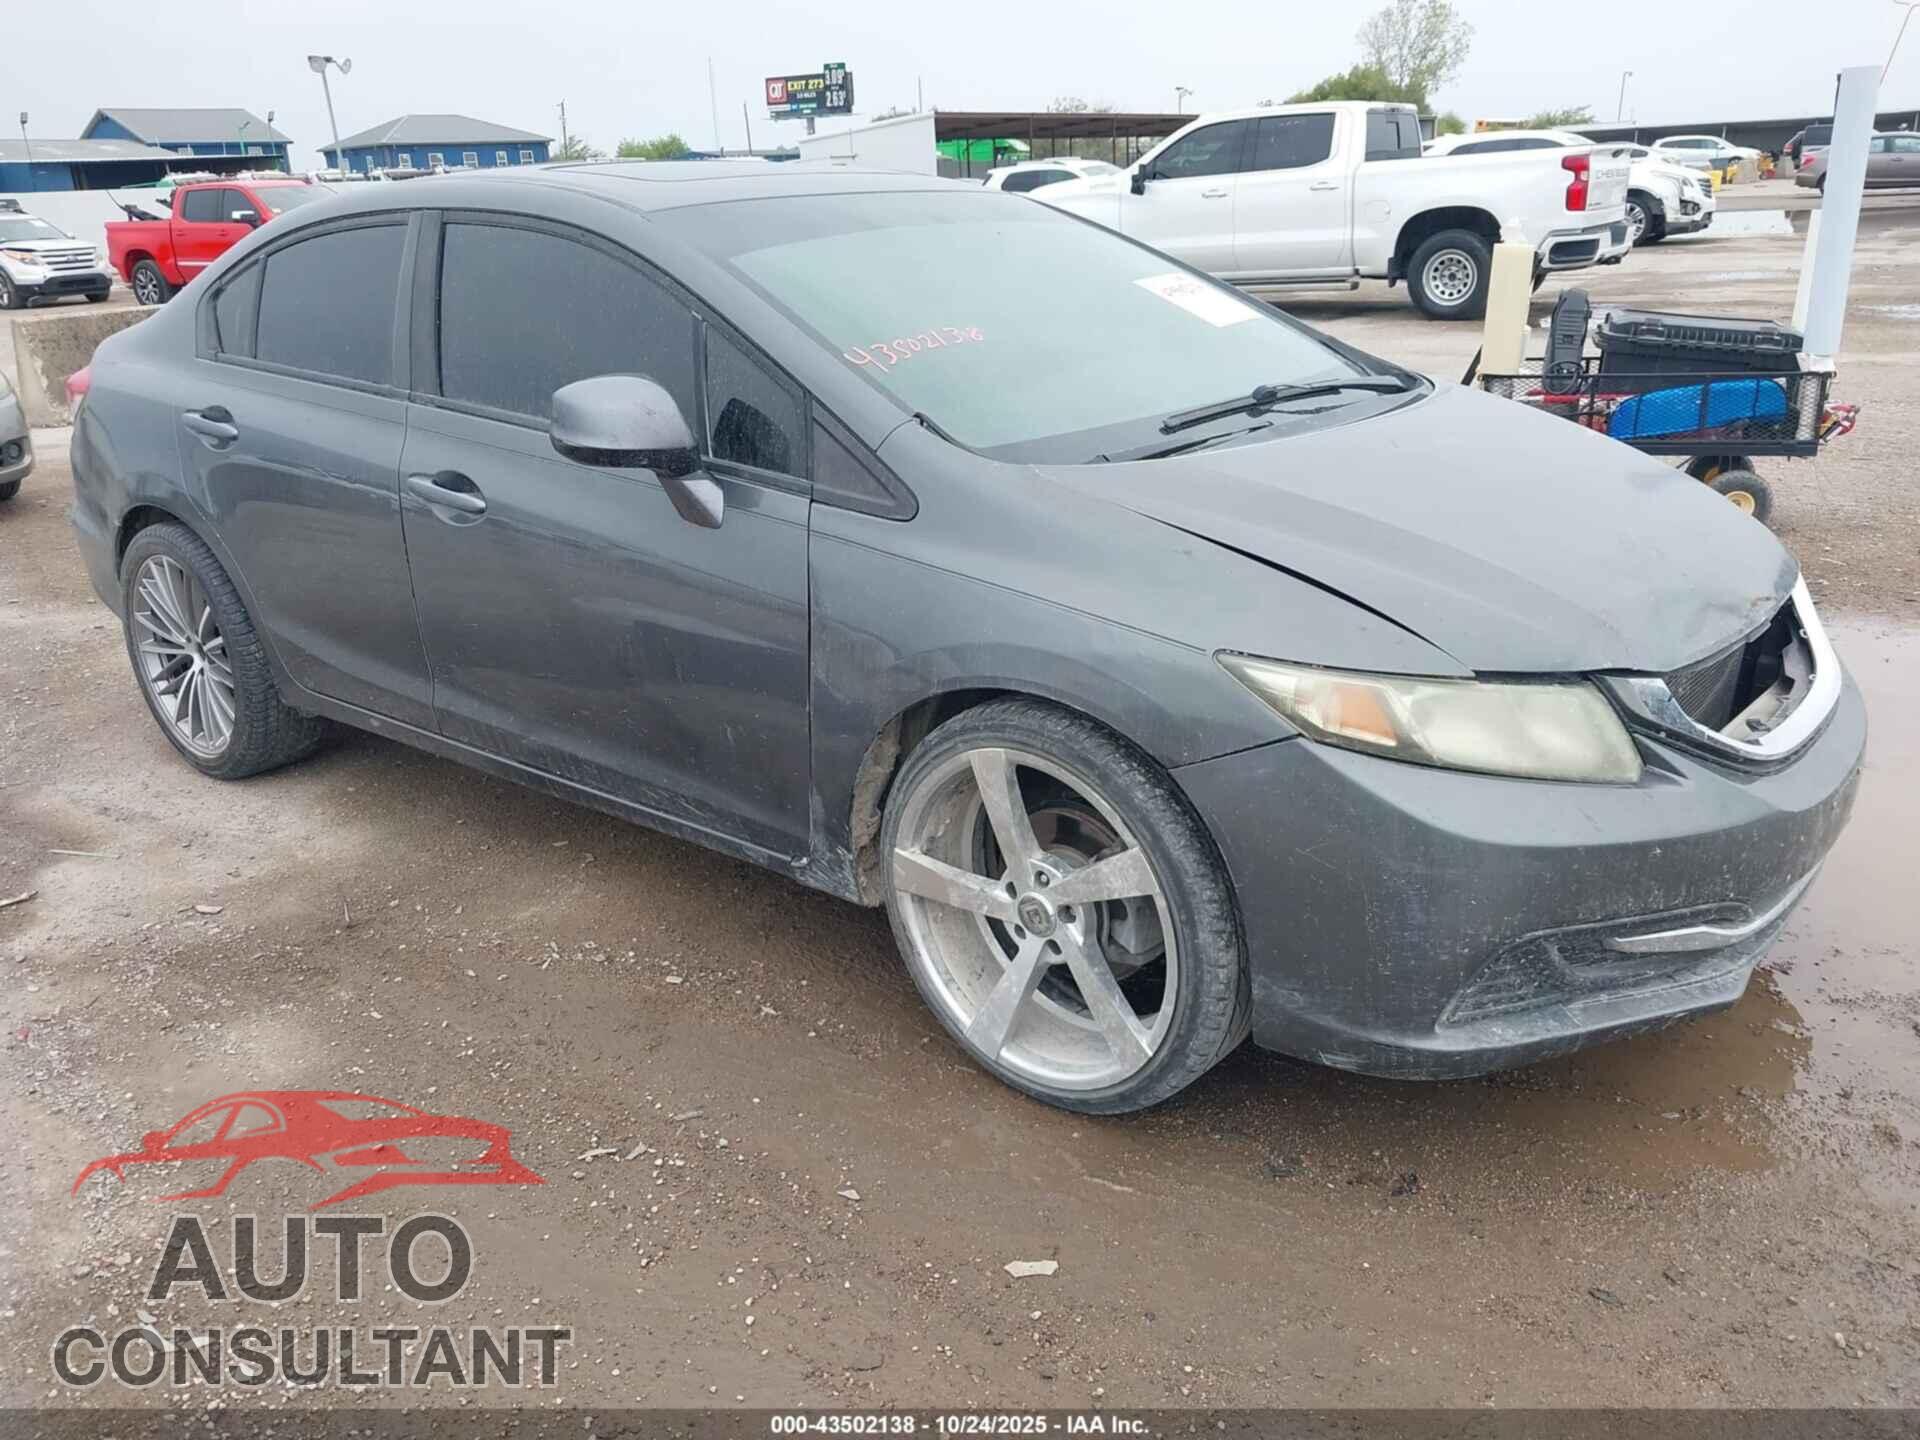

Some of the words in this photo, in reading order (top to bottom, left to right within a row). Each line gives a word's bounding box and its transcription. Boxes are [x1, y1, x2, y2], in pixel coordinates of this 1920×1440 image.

[769, 83, 784, 98] QT
[788, 80, 806, 91] EXIT
[808, 78, 824, 89] 273
